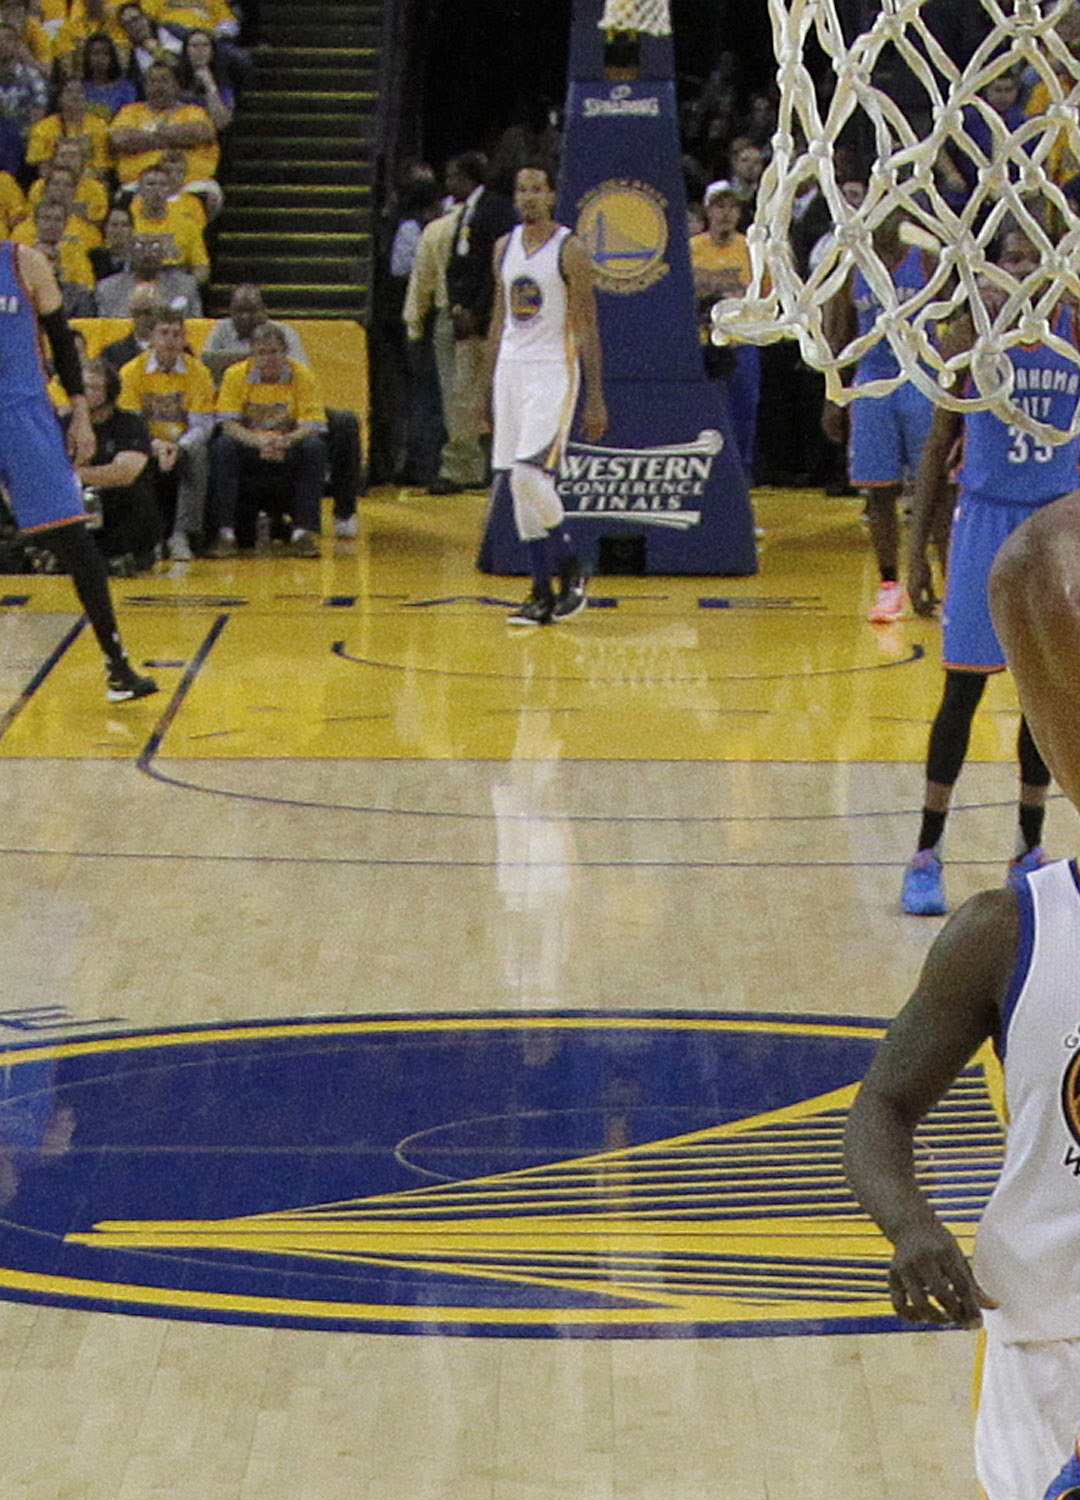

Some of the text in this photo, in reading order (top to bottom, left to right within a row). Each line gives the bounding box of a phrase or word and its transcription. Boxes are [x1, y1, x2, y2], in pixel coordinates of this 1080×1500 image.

[1016, 367, 1080, 395] AHOMA
[561, 455, 712, 480] WESTERN
[556, 480, 704, 495] CONFERENCE
[578, 495, 682, 510] FINALS
